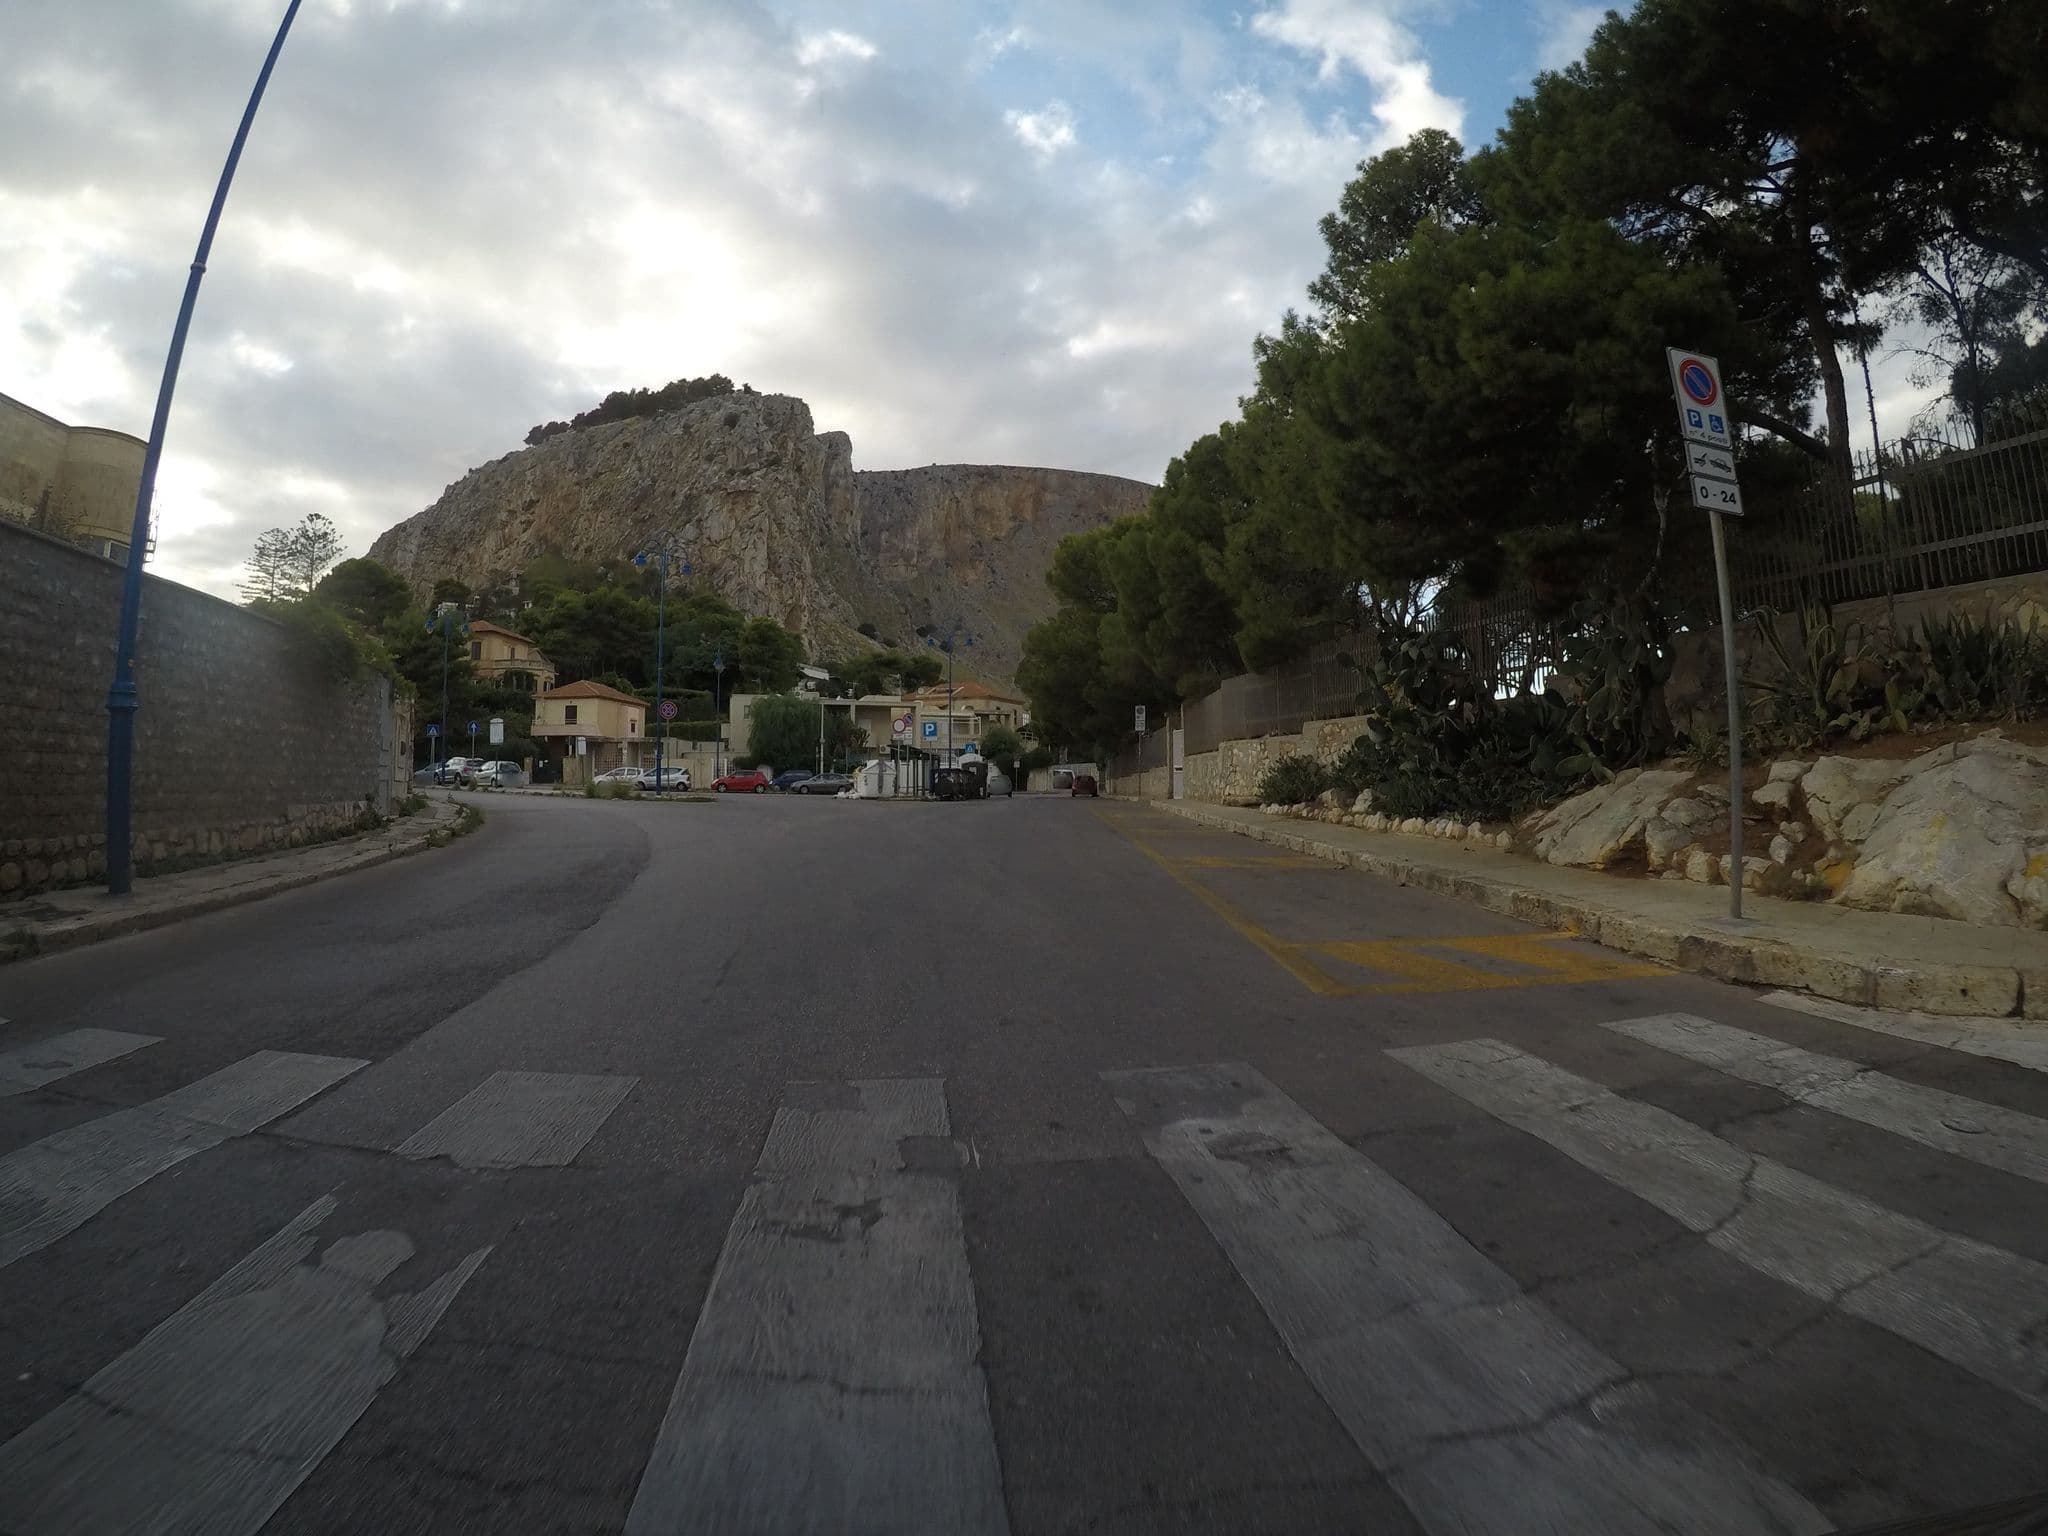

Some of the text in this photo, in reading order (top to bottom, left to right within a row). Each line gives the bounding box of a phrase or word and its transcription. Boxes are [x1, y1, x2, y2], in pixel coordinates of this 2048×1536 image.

[1690, 412, 1699, 425] P
[1720, 490, 1736, 505] 24
[925, 723, 934, 735] P
